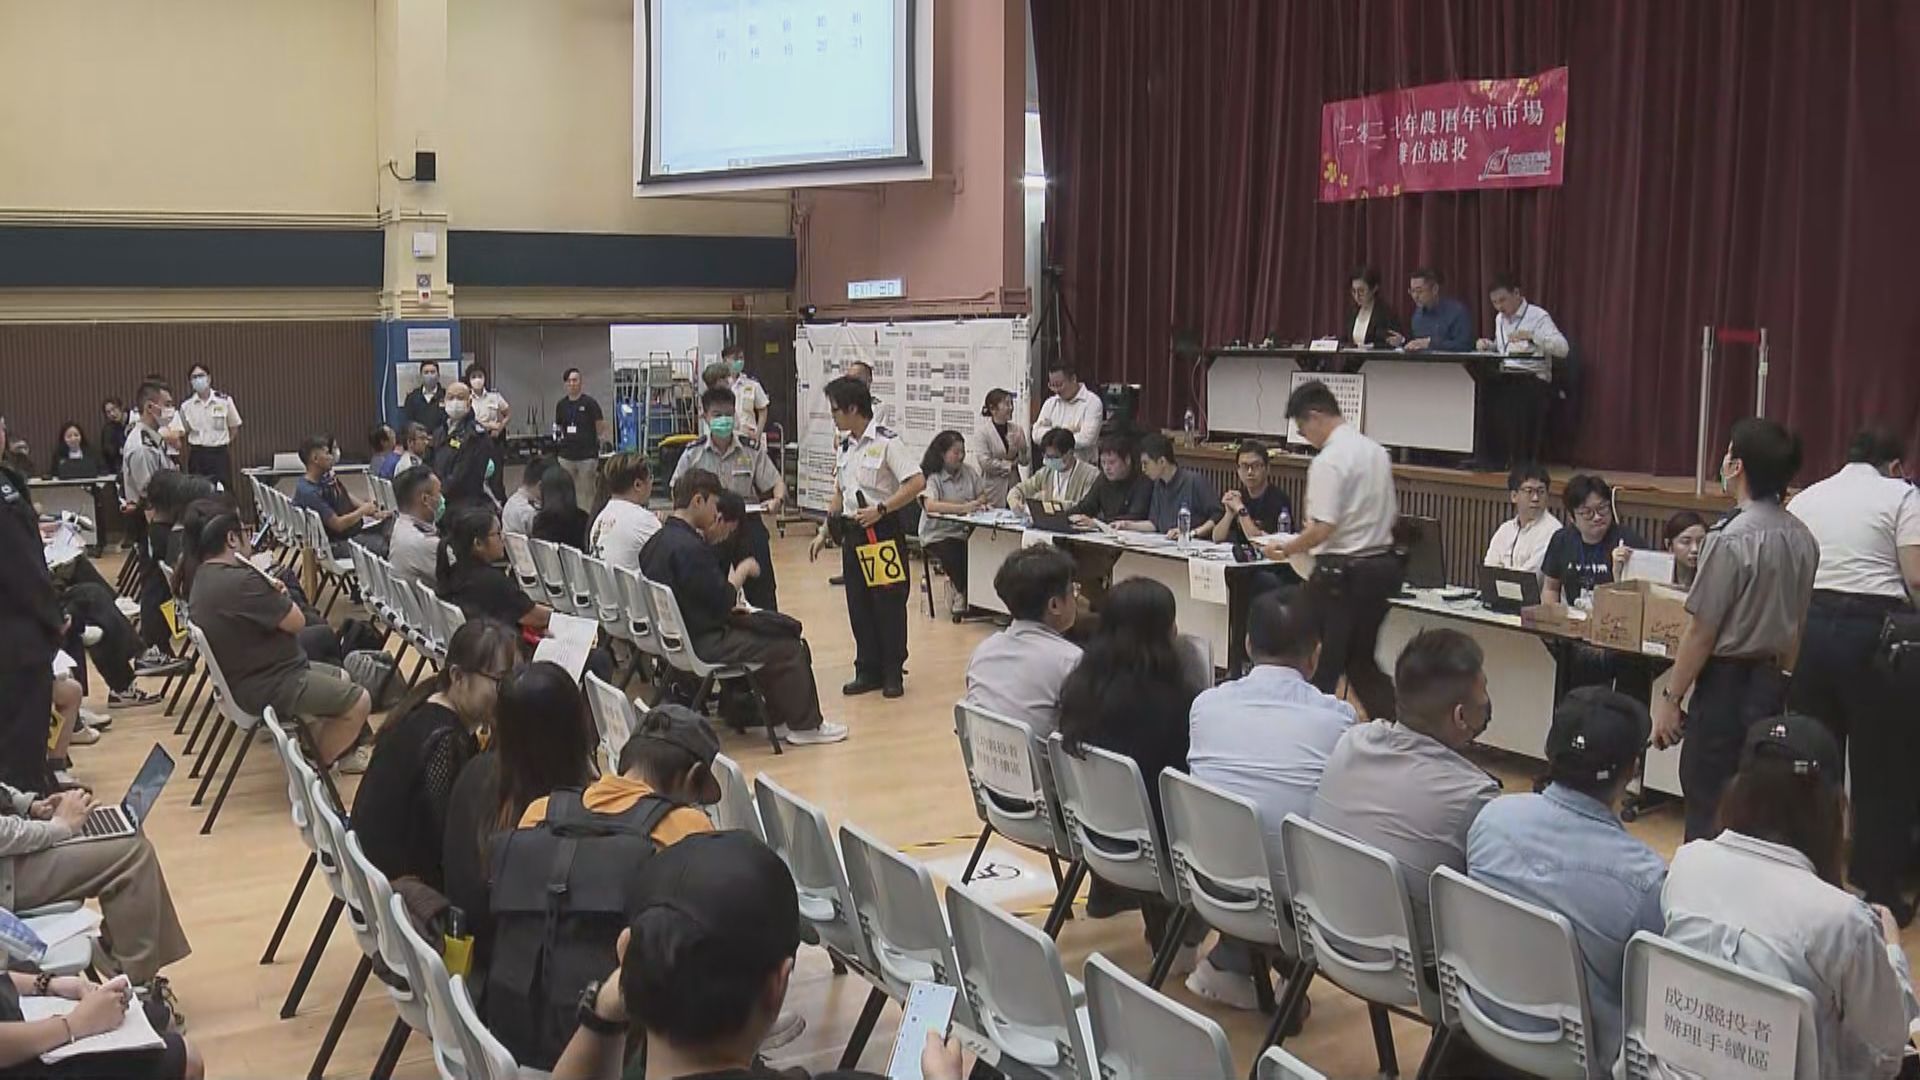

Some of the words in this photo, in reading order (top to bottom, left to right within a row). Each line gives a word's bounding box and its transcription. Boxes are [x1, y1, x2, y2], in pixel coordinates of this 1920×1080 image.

[860, 545, 901, 582] 84
[1664, 986, 1772, 1043] 成功競投者
[1664, 1012, 1770, 1071] 辦理手續區
